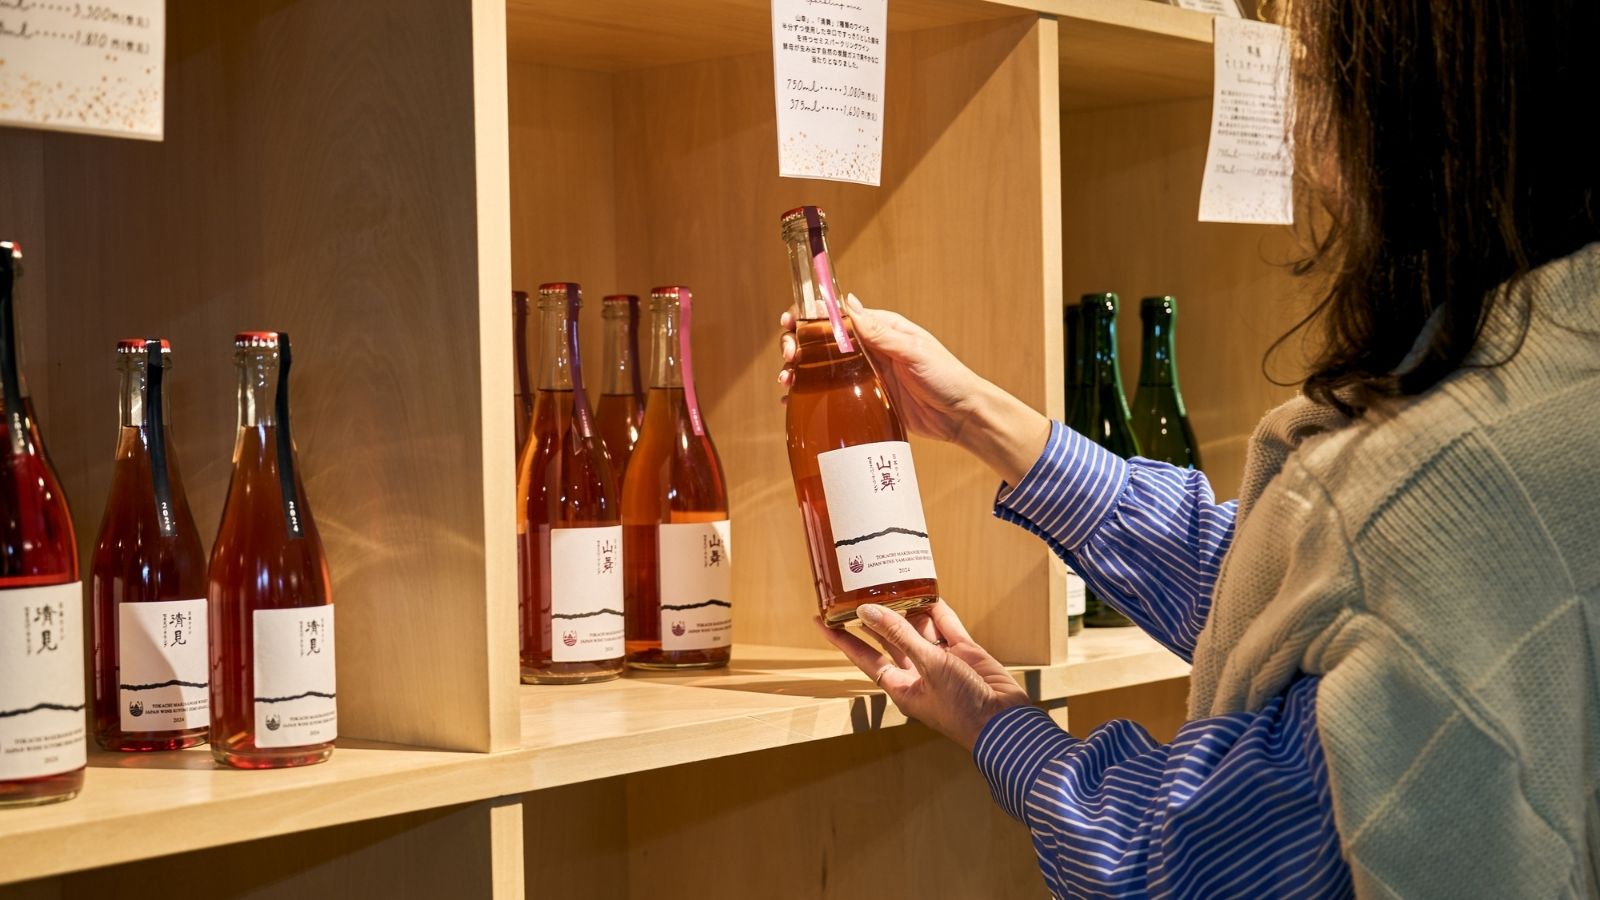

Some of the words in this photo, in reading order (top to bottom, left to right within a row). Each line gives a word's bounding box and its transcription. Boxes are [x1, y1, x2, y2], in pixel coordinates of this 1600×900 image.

[161, 502, 172, 532] 2024
[288, 500, 299, 533] 2024
[33, 603, 58, 655] 清見
[169, 611, 187, 648] 清見
[305, 619, 321, 656] 清見
